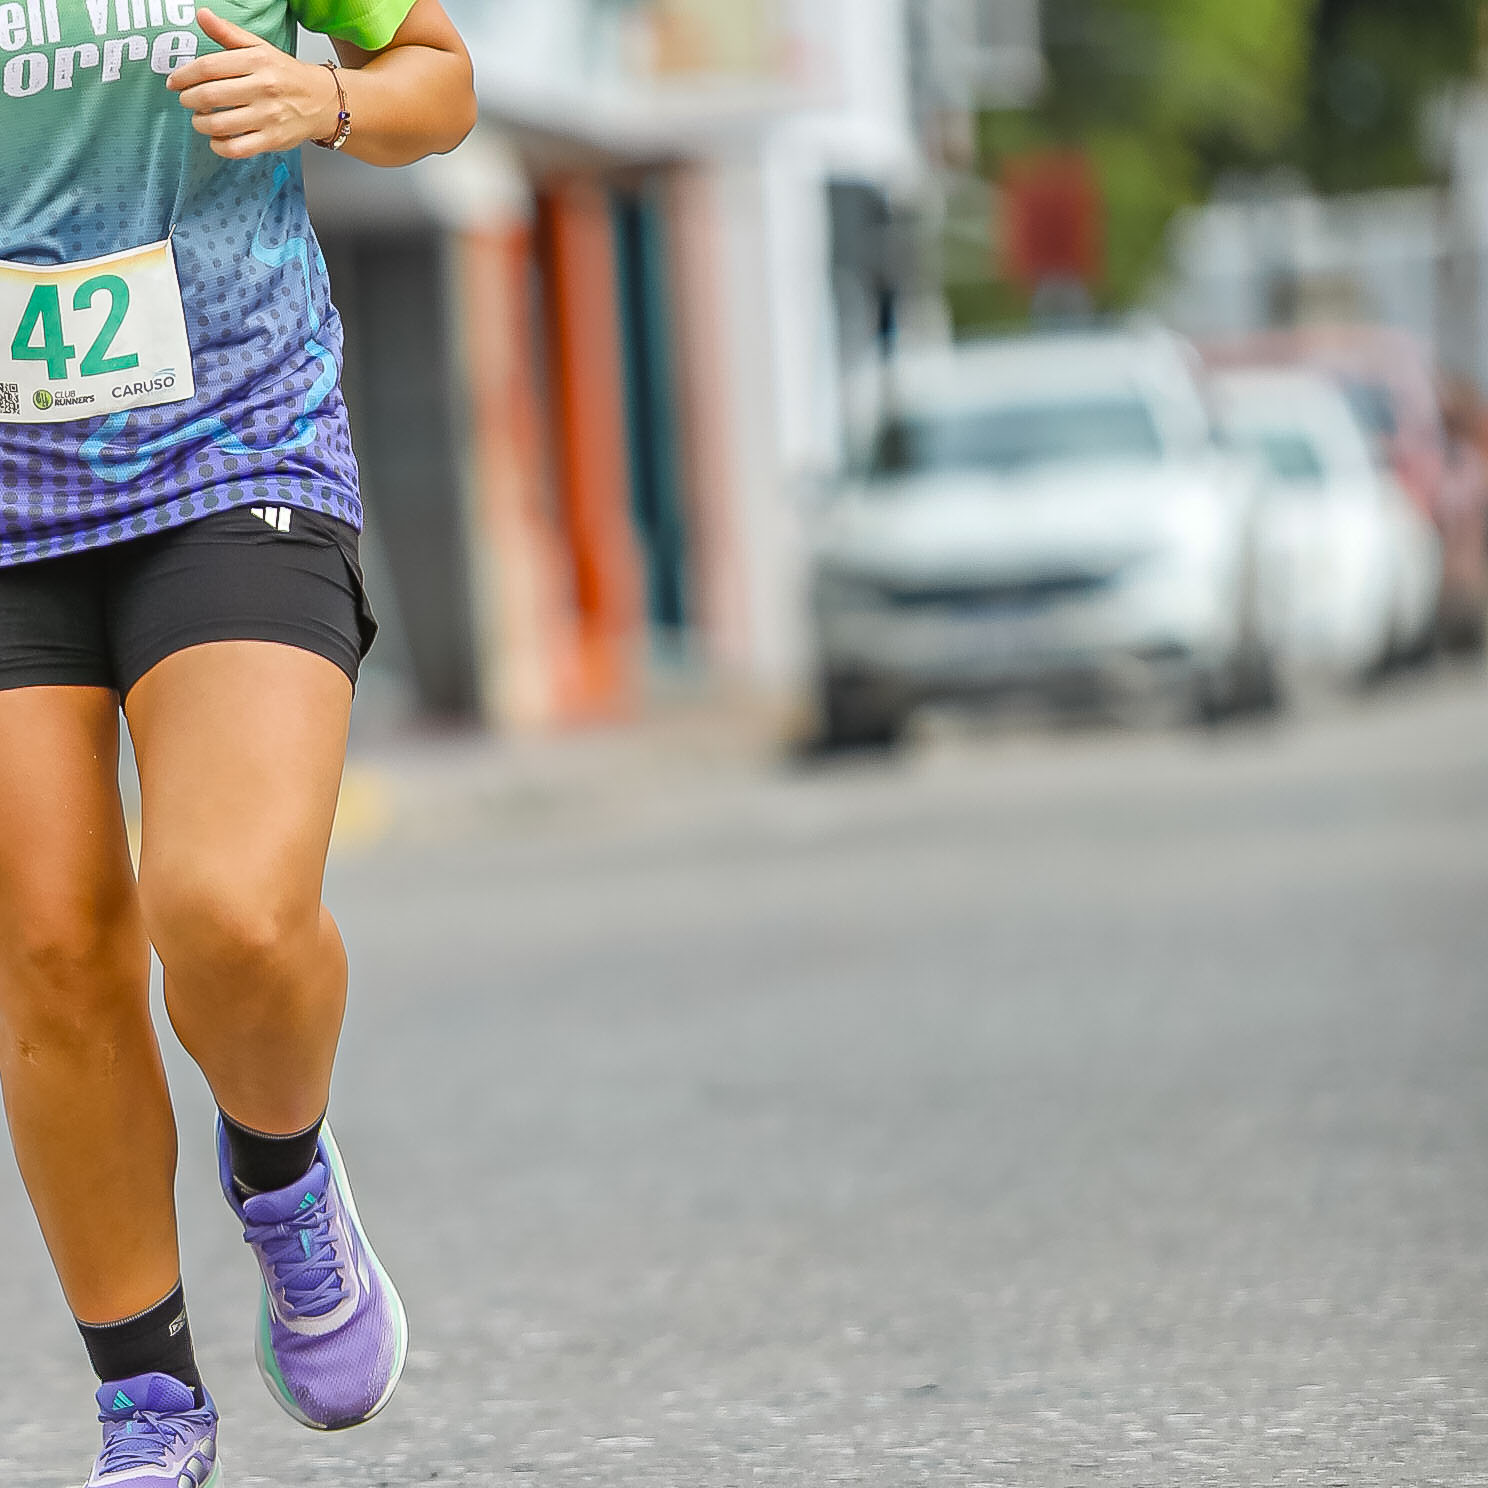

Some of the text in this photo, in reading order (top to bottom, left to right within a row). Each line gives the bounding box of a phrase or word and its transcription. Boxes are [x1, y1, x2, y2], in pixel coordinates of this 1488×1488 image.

[11, 274, 139, 380] 42
[54, 390, 76, 399] CLUB
[111, 376, 175, 398] CARUSO
[54, 394, 95, 407] RUNNER'S
